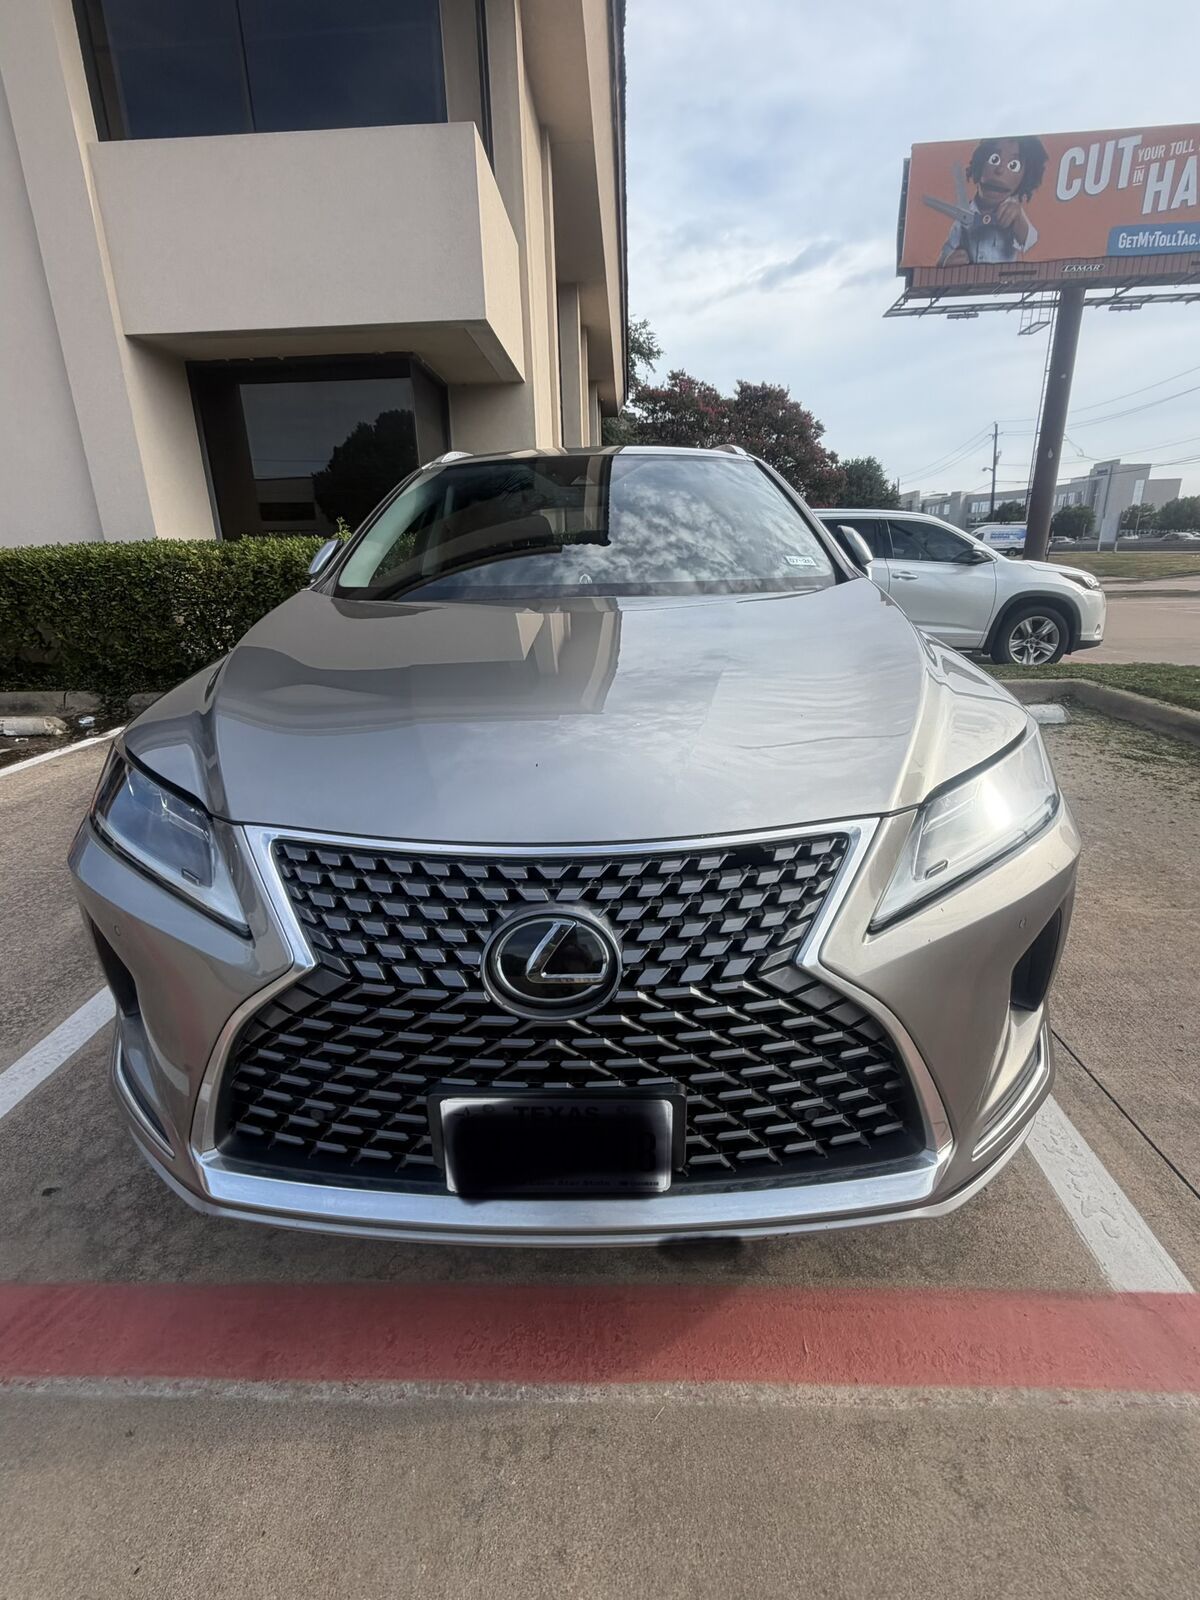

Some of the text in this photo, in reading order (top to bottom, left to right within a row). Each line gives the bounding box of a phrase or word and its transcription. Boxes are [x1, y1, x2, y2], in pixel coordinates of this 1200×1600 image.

[1137, 138, 1195, 162] YOUR TOLL
[1056, 134, 1143, 201] CUT
[1133, 168, 1145, 183] IN
[1118, 230, 1200, 248] GETMYTOLLTAG.
[1063, 264, 1101, 273] LAMAR
[513, 1105, 600, 1121] TEXAS
